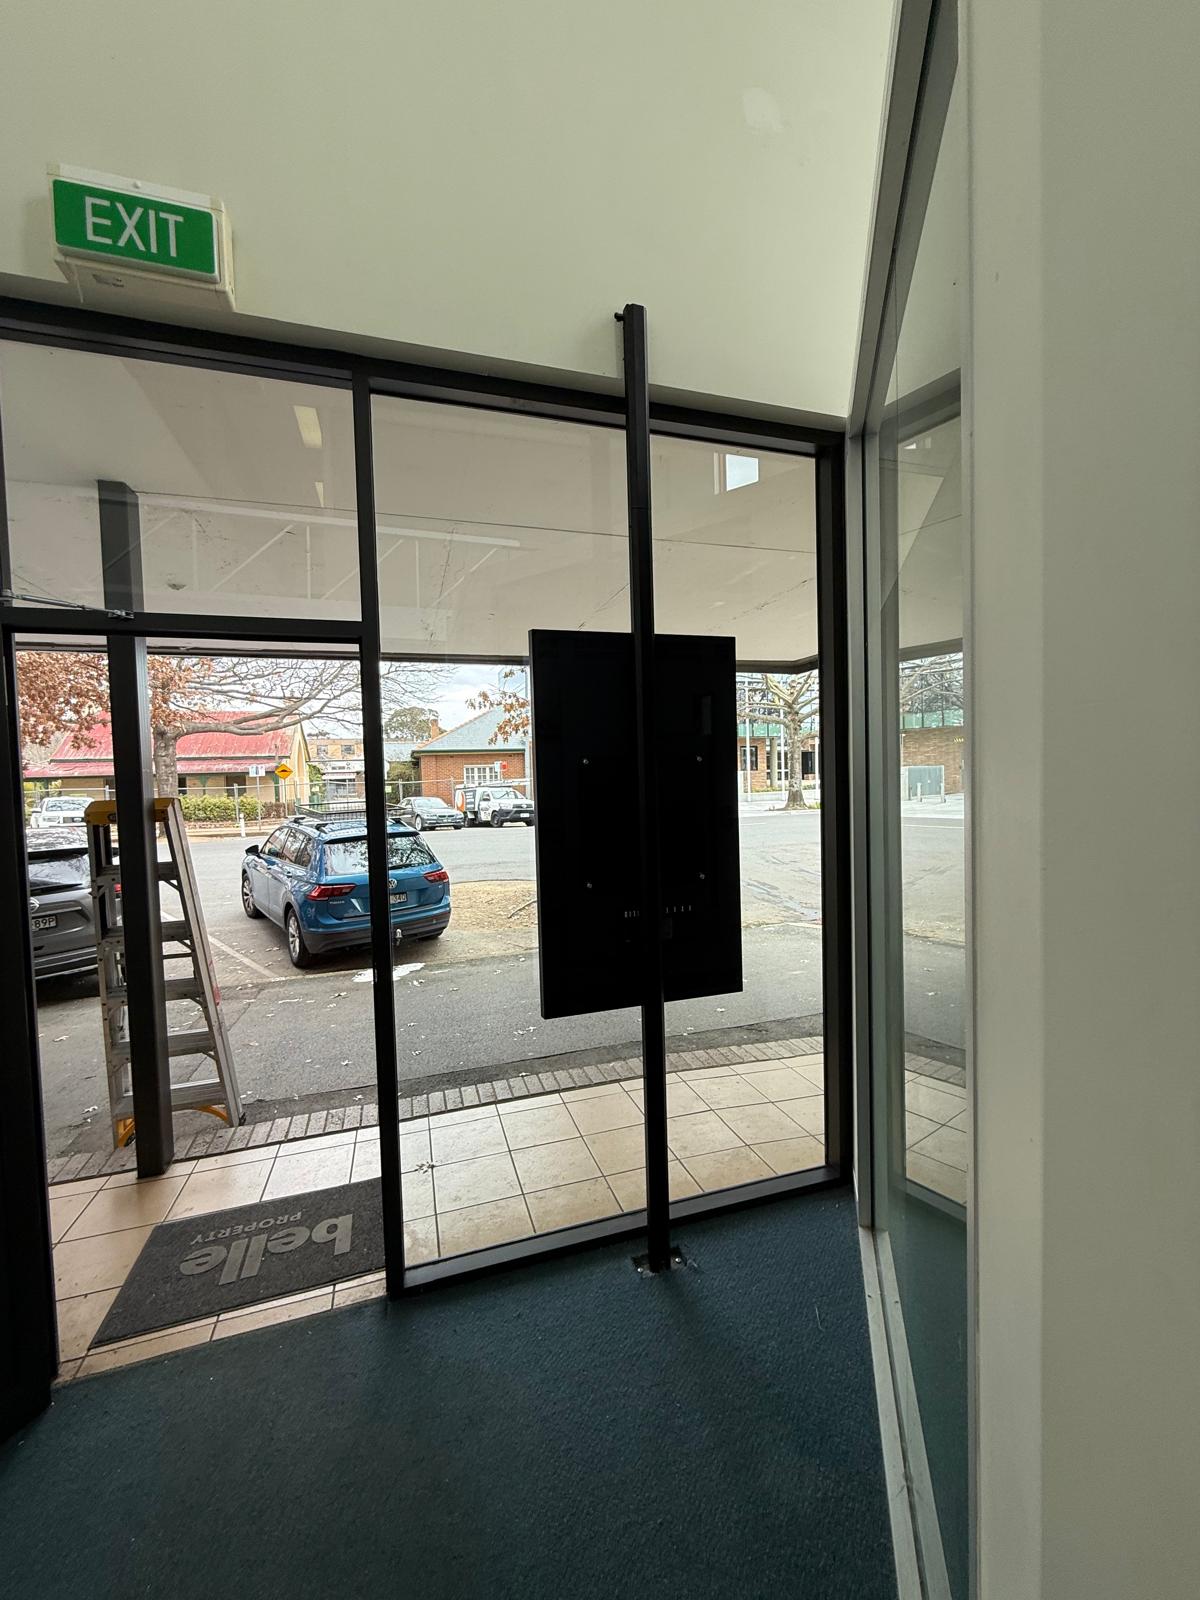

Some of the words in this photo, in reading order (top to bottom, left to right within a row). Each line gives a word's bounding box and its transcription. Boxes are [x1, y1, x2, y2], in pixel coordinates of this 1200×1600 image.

[84, 196, 184, 258] EXIT
[179, 1213, 353, 1286] belle
[191, 1213, 302, 1245] PROPERTY
